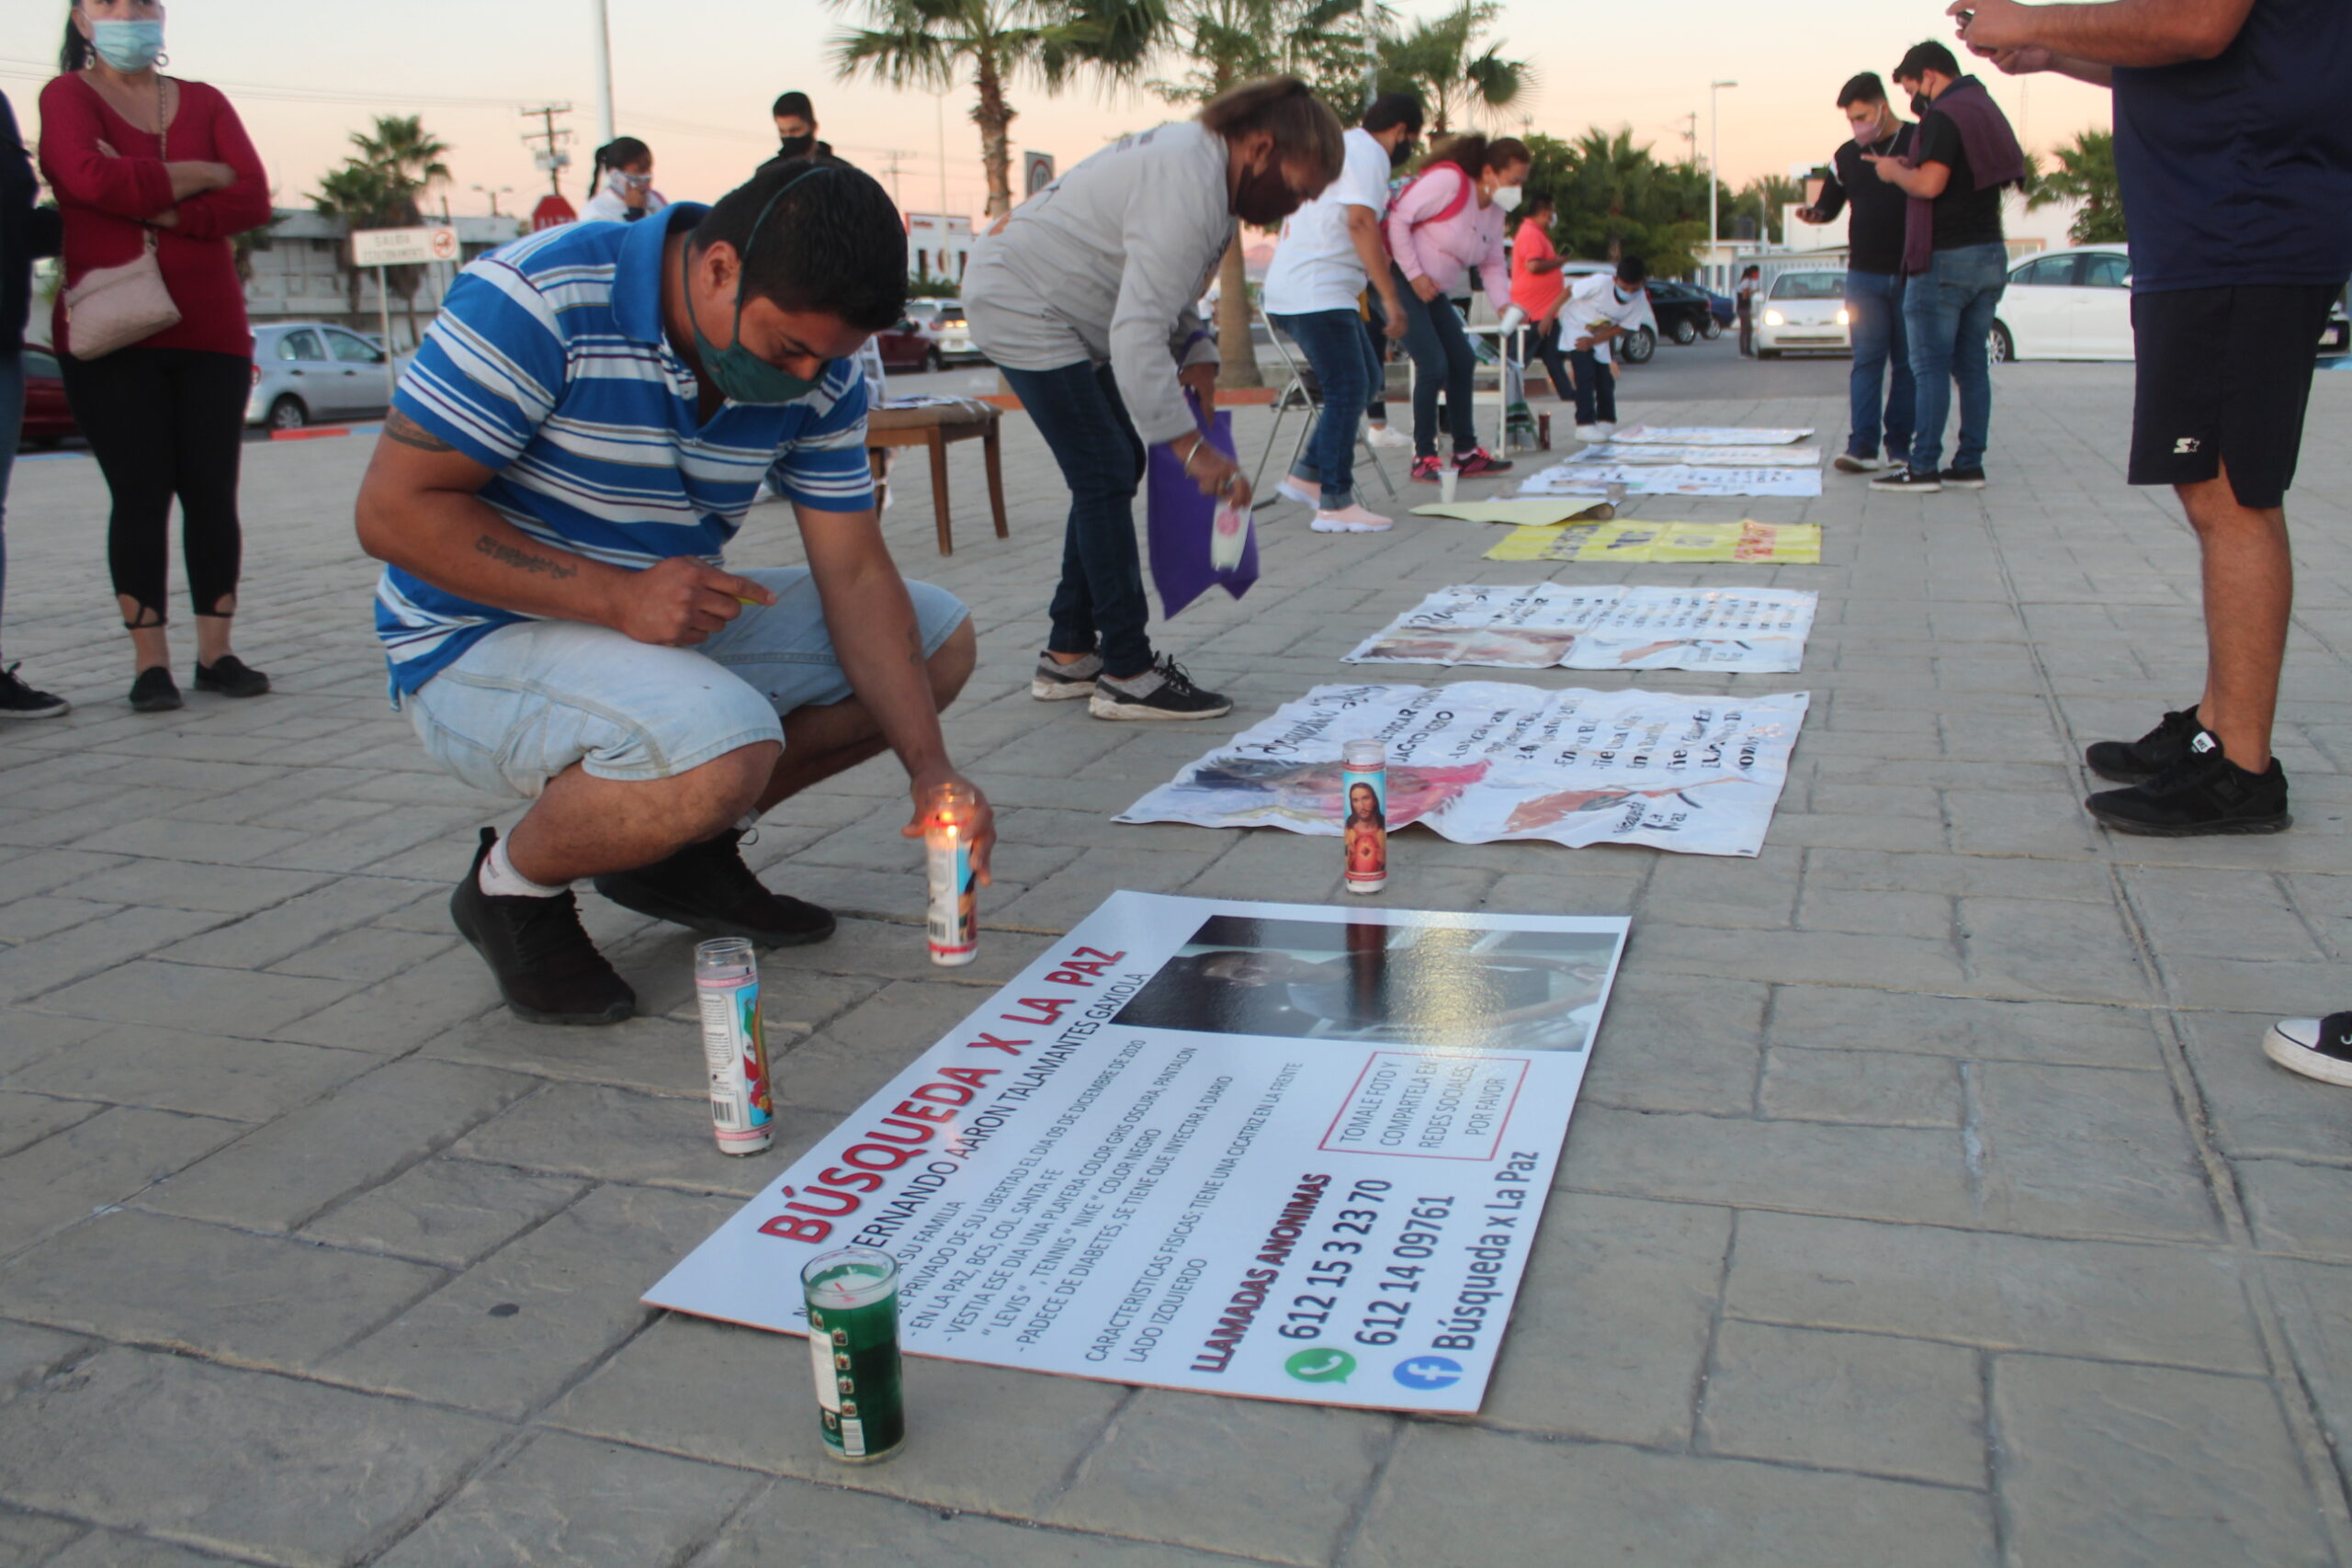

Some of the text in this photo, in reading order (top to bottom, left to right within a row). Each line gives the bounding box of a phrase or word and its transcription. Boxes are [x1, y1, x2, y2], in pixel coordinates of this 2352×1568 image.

[944, 1105, 1017, 1159] AARON
[997, 1021, 1101, 1100] TALAMANTES
[1085, 975, 1148, 1019] GAXIOLA
[1108, 1059, 1129, 1068] DE
[1118, 1040, 1146, 1058] 2020
[757, 1067, 1001, 1244] BÚSQUEDA
[967, 1032, 1033, 1055] X
[1001, 998, 1076, 1025] LA
[1044, 946, 1125, 987] PAZ
[1069, 1070, 1119, 1112] DICIEMBRE
[1200, 1077, 1233, 1103] DIARIO
[1252, 1105, 1274, 1116] EN
[1261, 1093, 1282, 1102] LA
[1340, 1099, 1382, 1142] TOMALE
[1365, 1070, 1396, 1096] FOTO
[1464, 1078, 1507, 1135] POR FAVOR
[1046, 1126, 1068, 1137] 09
[1057, 1113, 1080, 1124] DE
[1379, 1078, 1429, 1145] COMPARTELA
[1419, 1115, 1453, 1148] REDES
[1030, 1140, 1057, 1155] DIA
[1162, 1113, 1206, 1154] INYECTAR
[1227, 1118, 1266, 1156] CICATRIZ
[1019, 1157, 1042, 1167] EL
[1147, 1156, 1175, 1175] QUE
[1210, 1158, 1239, 1179] UNA
[944, 1294, 995, 1332] VESTIA
[981, 1270, 1013, 1290] ESE
[1001, 1249, 1032, 1268] DIA
[1019, 1223, 1054, 1246] UNA
[1041, 1179, 1090, 1220] PLAYERA
[1079, 1145, 1117, 1176] COLOR
[1106, 1124, 1134, 1144] GRIS
[1153, 1048, 1197, 1086] PANTALON
[977, 1168, 1029, 1213] LIBERTAD
[1030, 1237, 1076, 1276] TENNIS
[1098, 1162, 1136, 1193] COLOR
[1125, 1129, 1161, 1160] NEGRO
[1122, 1178, 1159, 1204] TIENE
[1189, 1180, 1224, 1208] TIENE
[892, 1244, 922, 1259] SU
[912, 1202, 965, 1242] FAMILIA
[962, 1214, 987, 1229] SU
[1112, 1207, 1136, 1220] SE
[910, 1312, 939, 1328] EN
[927, 1295, 956, 1309] LA
[1012, 1183, 1052, 1213] SANTA
[1040, 1169, 1064, 1180] FE
[946, 1230, 974, 1246] DE
[1431, 1152, 1539, 1350] Búsqueda x La Paz
[896, 1247, 956, 1297] PRIVADO
[1191, 1174, 1331, 1372] LLAMADAS ANONIMAS
[1279, 1180, 1392, 1339] 612 15 3 23 70
[1354, 1197, 1454, 1345] 612 14 09761
[1055, 1279, 1082, 1294] DE
[1016, 1297, 1069, 1344] PADECE
[1085, 1256, 1173, 1361] CARACTERISTICAS
[1125, 1258, 1207, 1362] LADO IZQUIERDO
